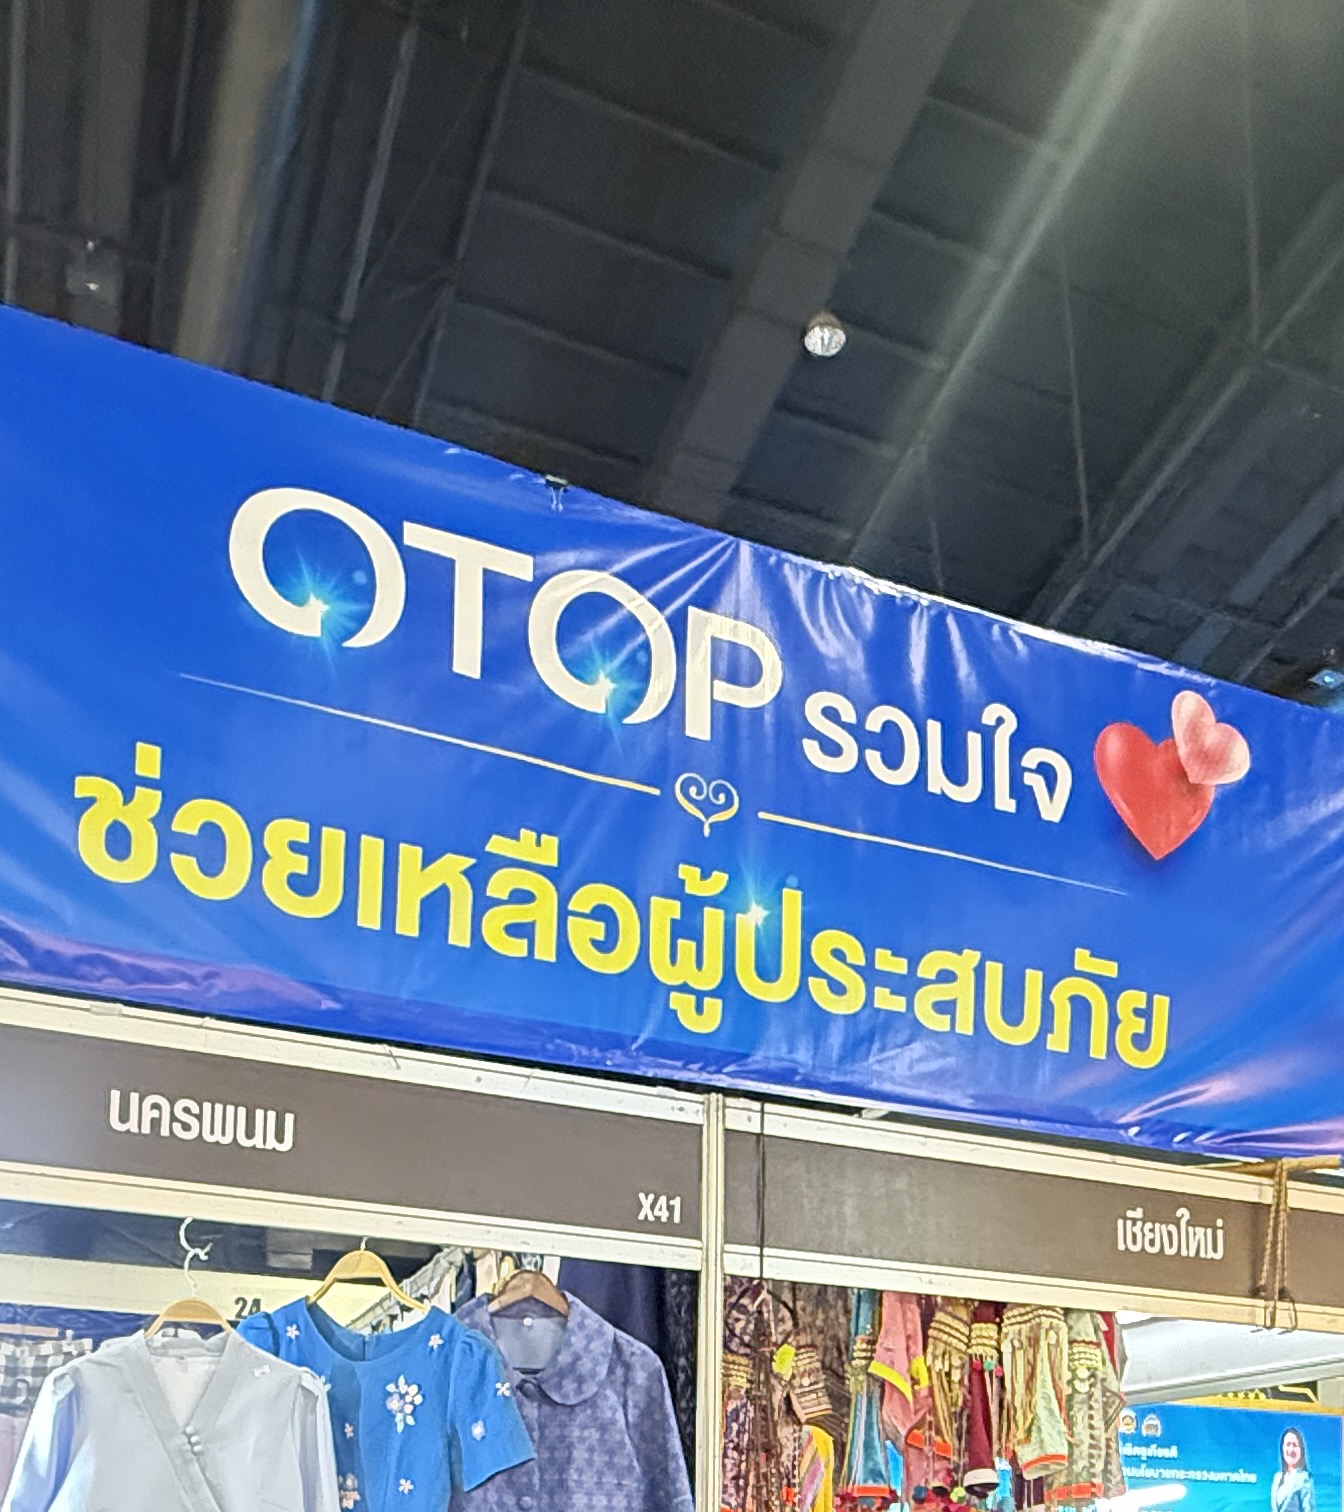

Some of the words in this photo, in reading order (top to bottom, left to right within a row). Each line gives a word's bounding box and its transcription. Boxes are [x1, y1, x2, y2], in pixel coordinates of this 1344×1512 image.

[228, 487, 785, 742] OTOP
[801, 703, 1074, 824] รวมใจ
[74, 742, 1171, 1070] ช่วยเหลือผู้ประสบภัย
[109, 1089, 296, 1152] นครพนม
[638, 1191, 682, 1224] X41
[1117, 1207, 1225, 1261] เชียงใหม่
[234, 1296, 262, 1320] 24
